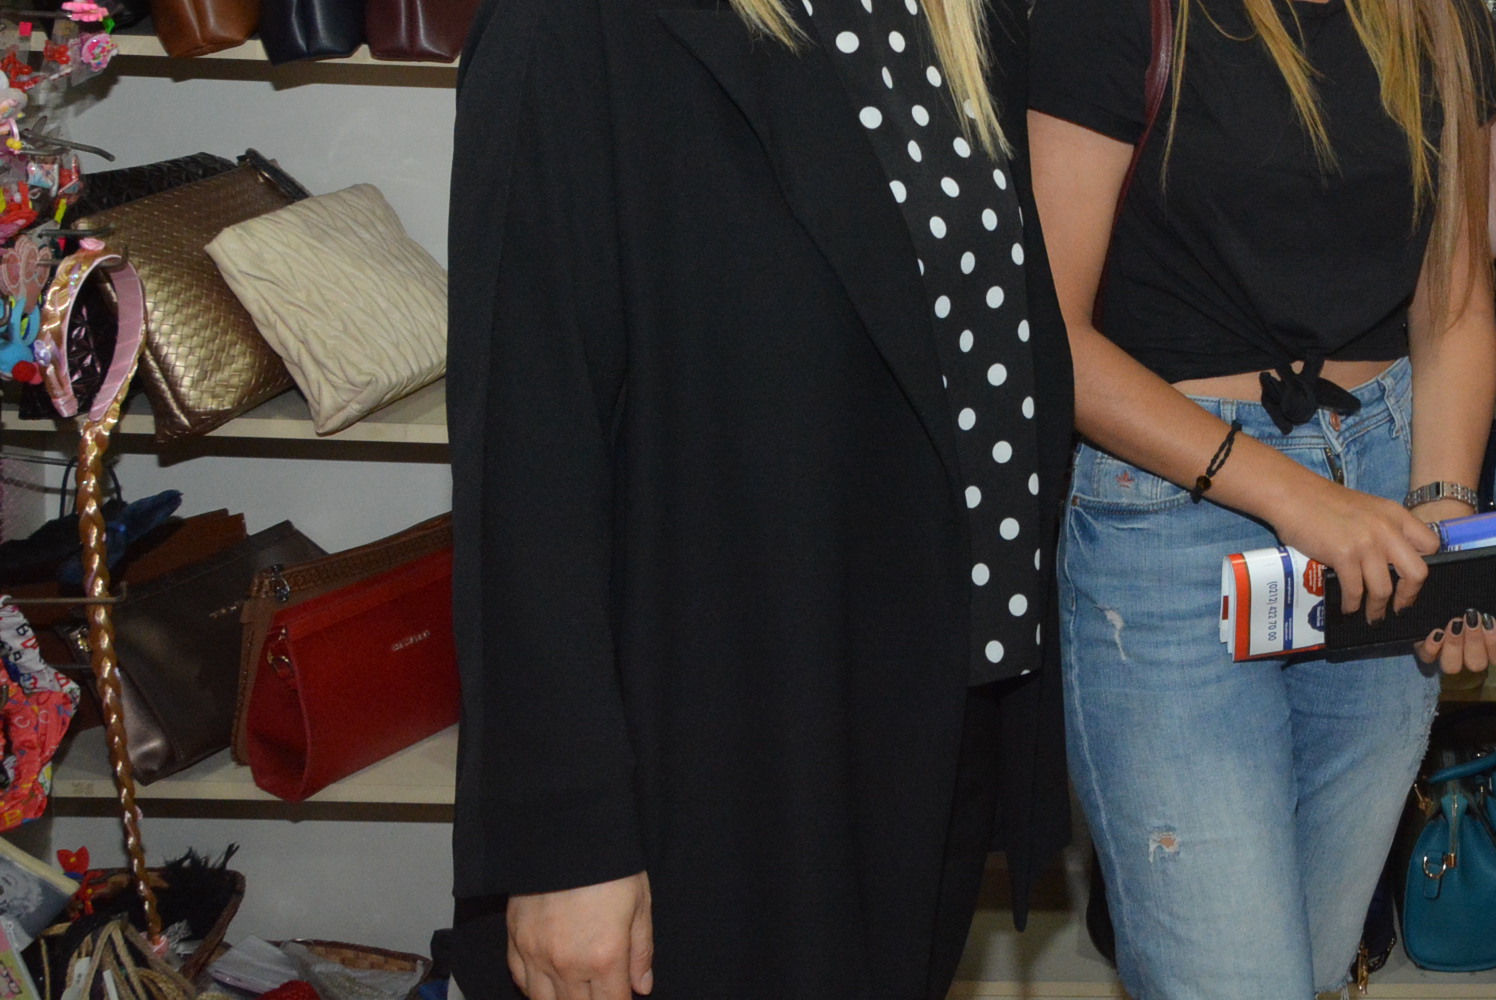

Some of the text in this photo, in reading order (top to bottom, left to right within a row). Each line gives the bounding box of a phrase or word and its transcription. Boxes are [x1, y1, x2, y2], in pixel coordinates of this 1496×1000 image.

[1266, 580, 1278, 641] (0212) 422 70 00
